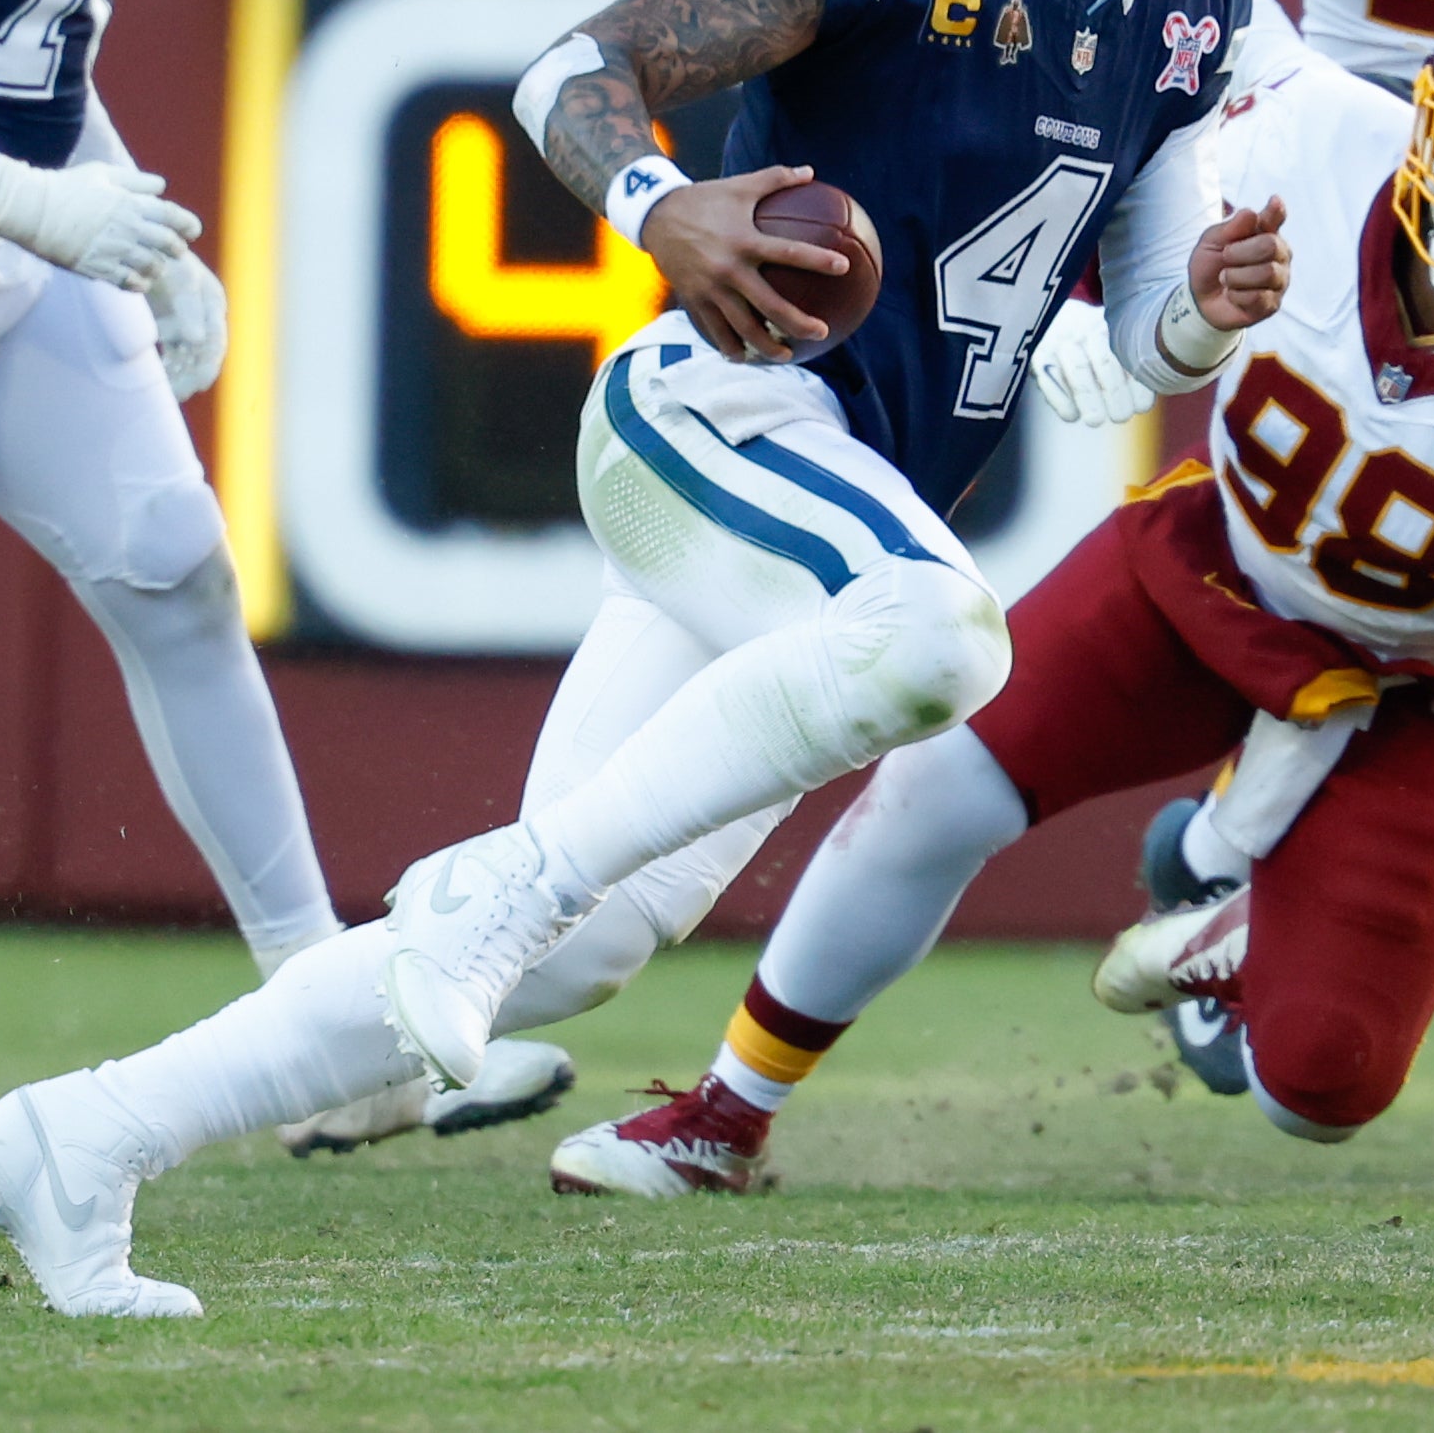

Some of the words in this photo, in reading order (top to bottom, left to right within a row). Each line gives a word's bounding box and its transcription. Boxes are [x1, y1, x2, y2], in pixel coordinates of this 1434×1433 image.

[1035, 116, 1100, 149] COWBOYS
[623, 167, 661, 198] 4
[934, 154, 1115, 419] 4
